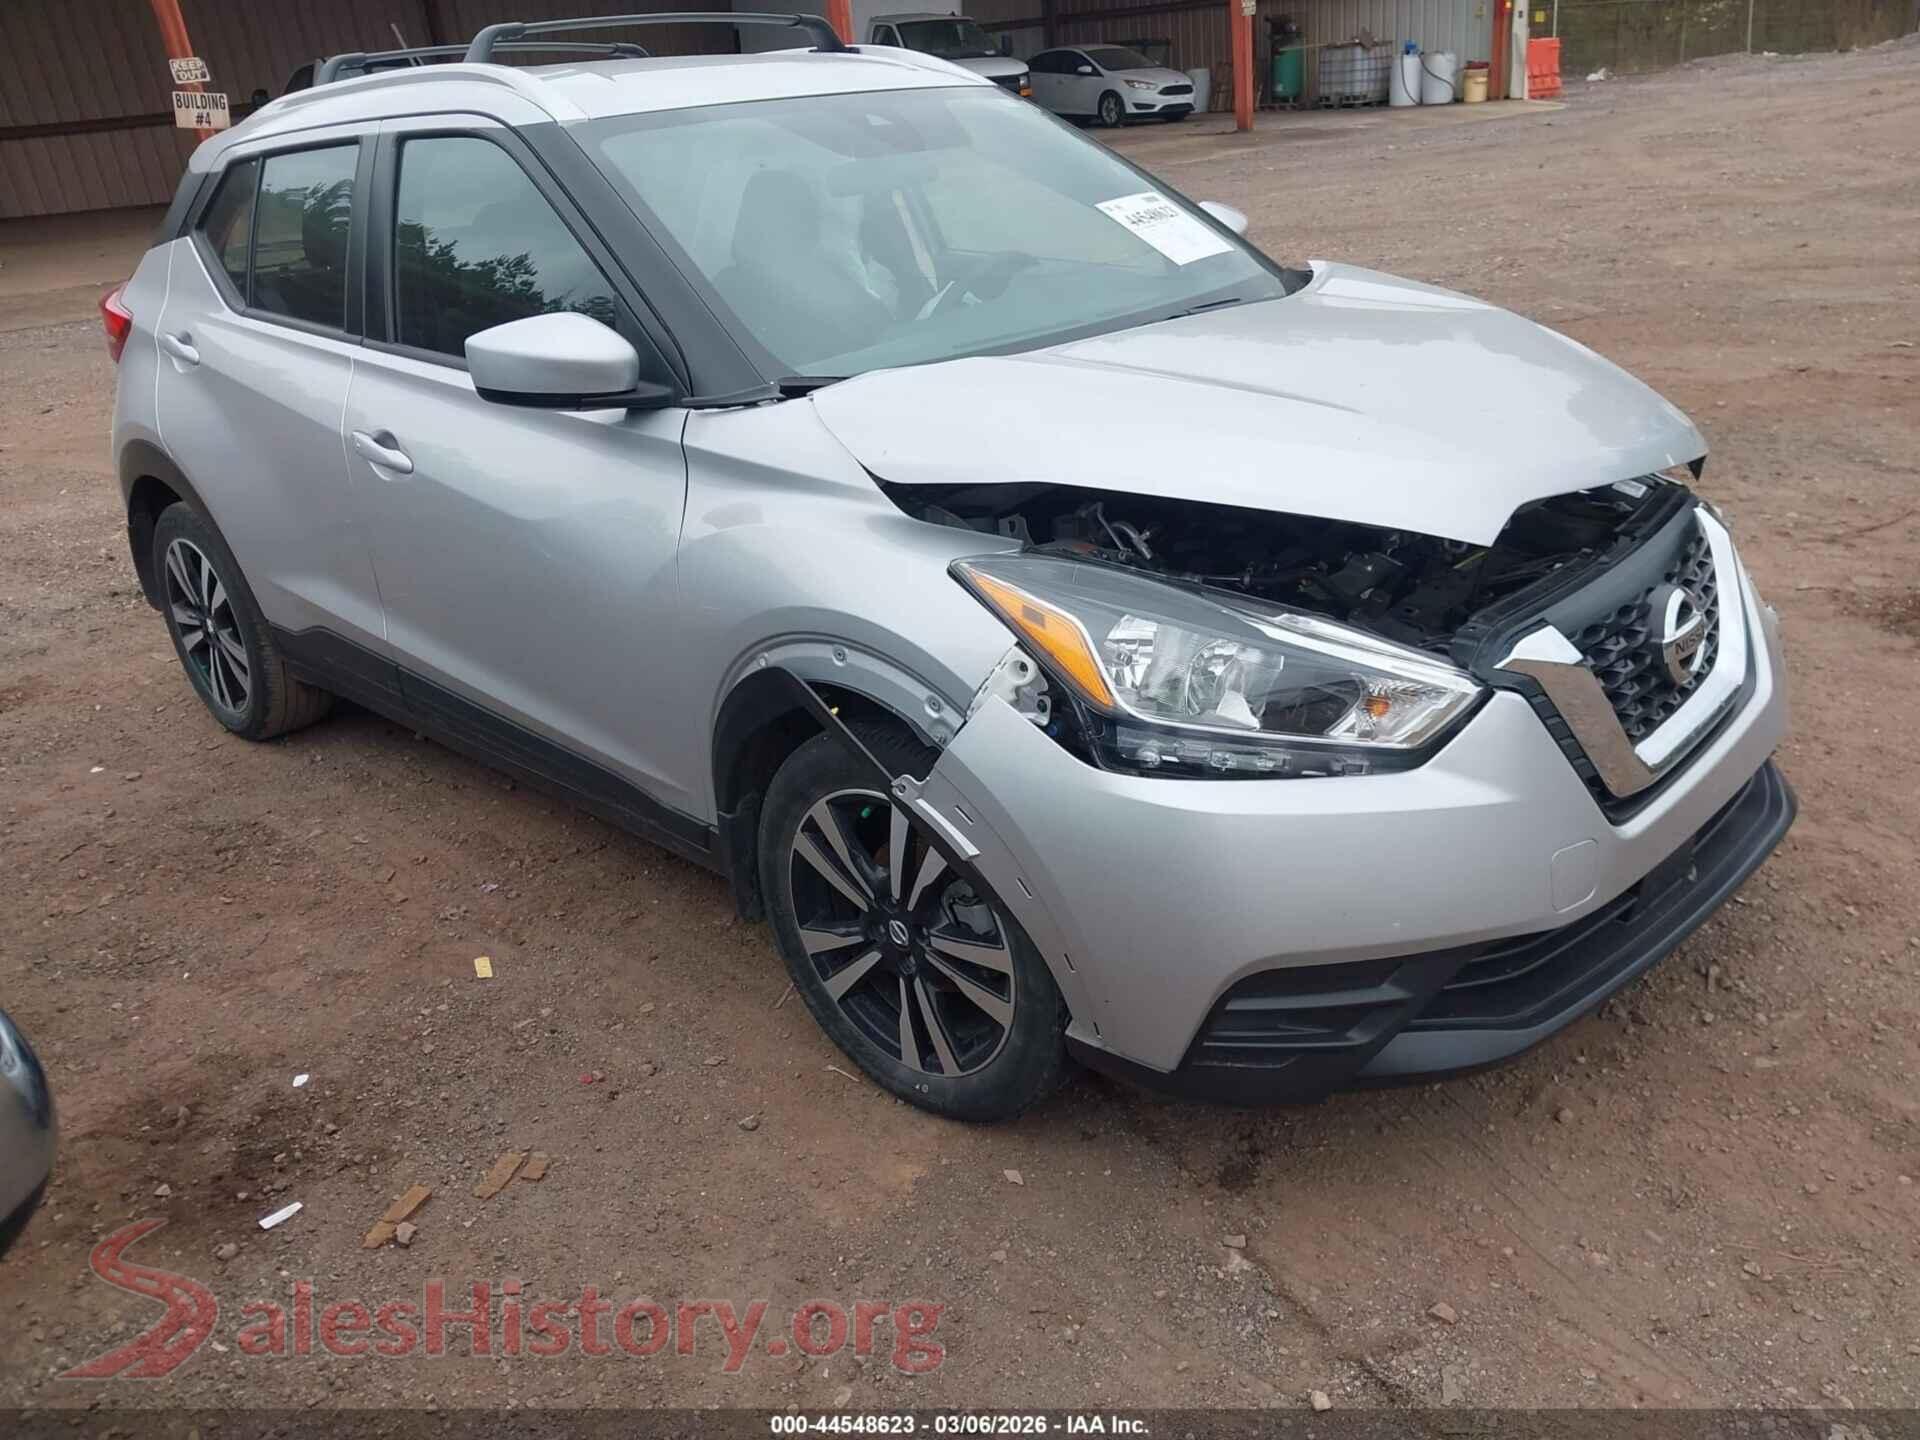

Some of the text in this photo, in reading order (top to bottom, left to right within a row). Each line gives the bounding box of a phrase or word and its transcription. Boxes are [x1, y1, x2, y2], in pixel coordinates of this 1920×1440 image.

[172, 61, 202, 71] KEEP
[178, 70, 202, 80] OUT
[175, 94, 226, 110] BUILDING
[195, 112, 211, 126] #4
